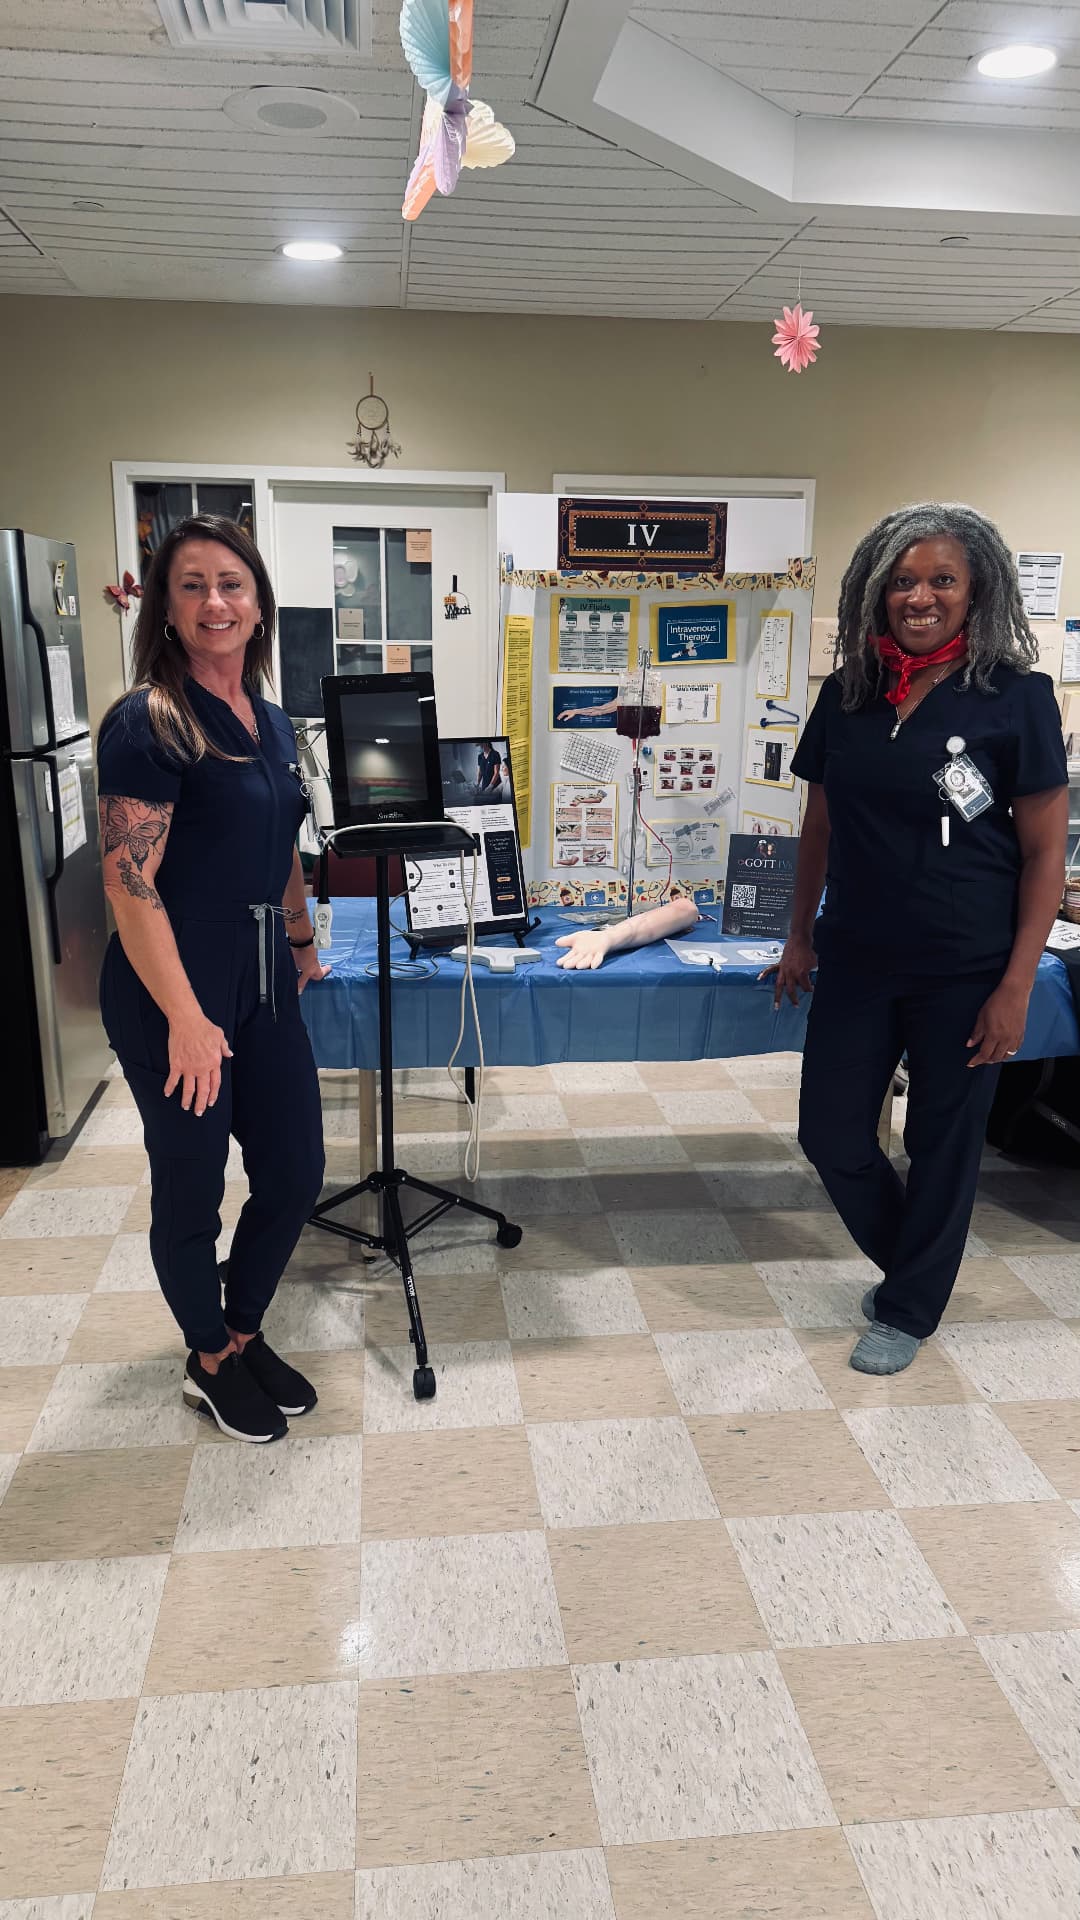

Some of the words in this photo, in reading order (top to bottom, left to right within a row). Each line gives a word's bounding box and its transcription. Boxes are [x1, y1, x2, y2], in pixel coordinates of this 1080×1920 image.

[627, 524, 660, 547] IV
[589, 603, 611, 611] Fluids
[670, 625, 717, 634] Intravenous
[678, 633, 711, 642] Therapy
[745, 858, 777, 869] GOTT
